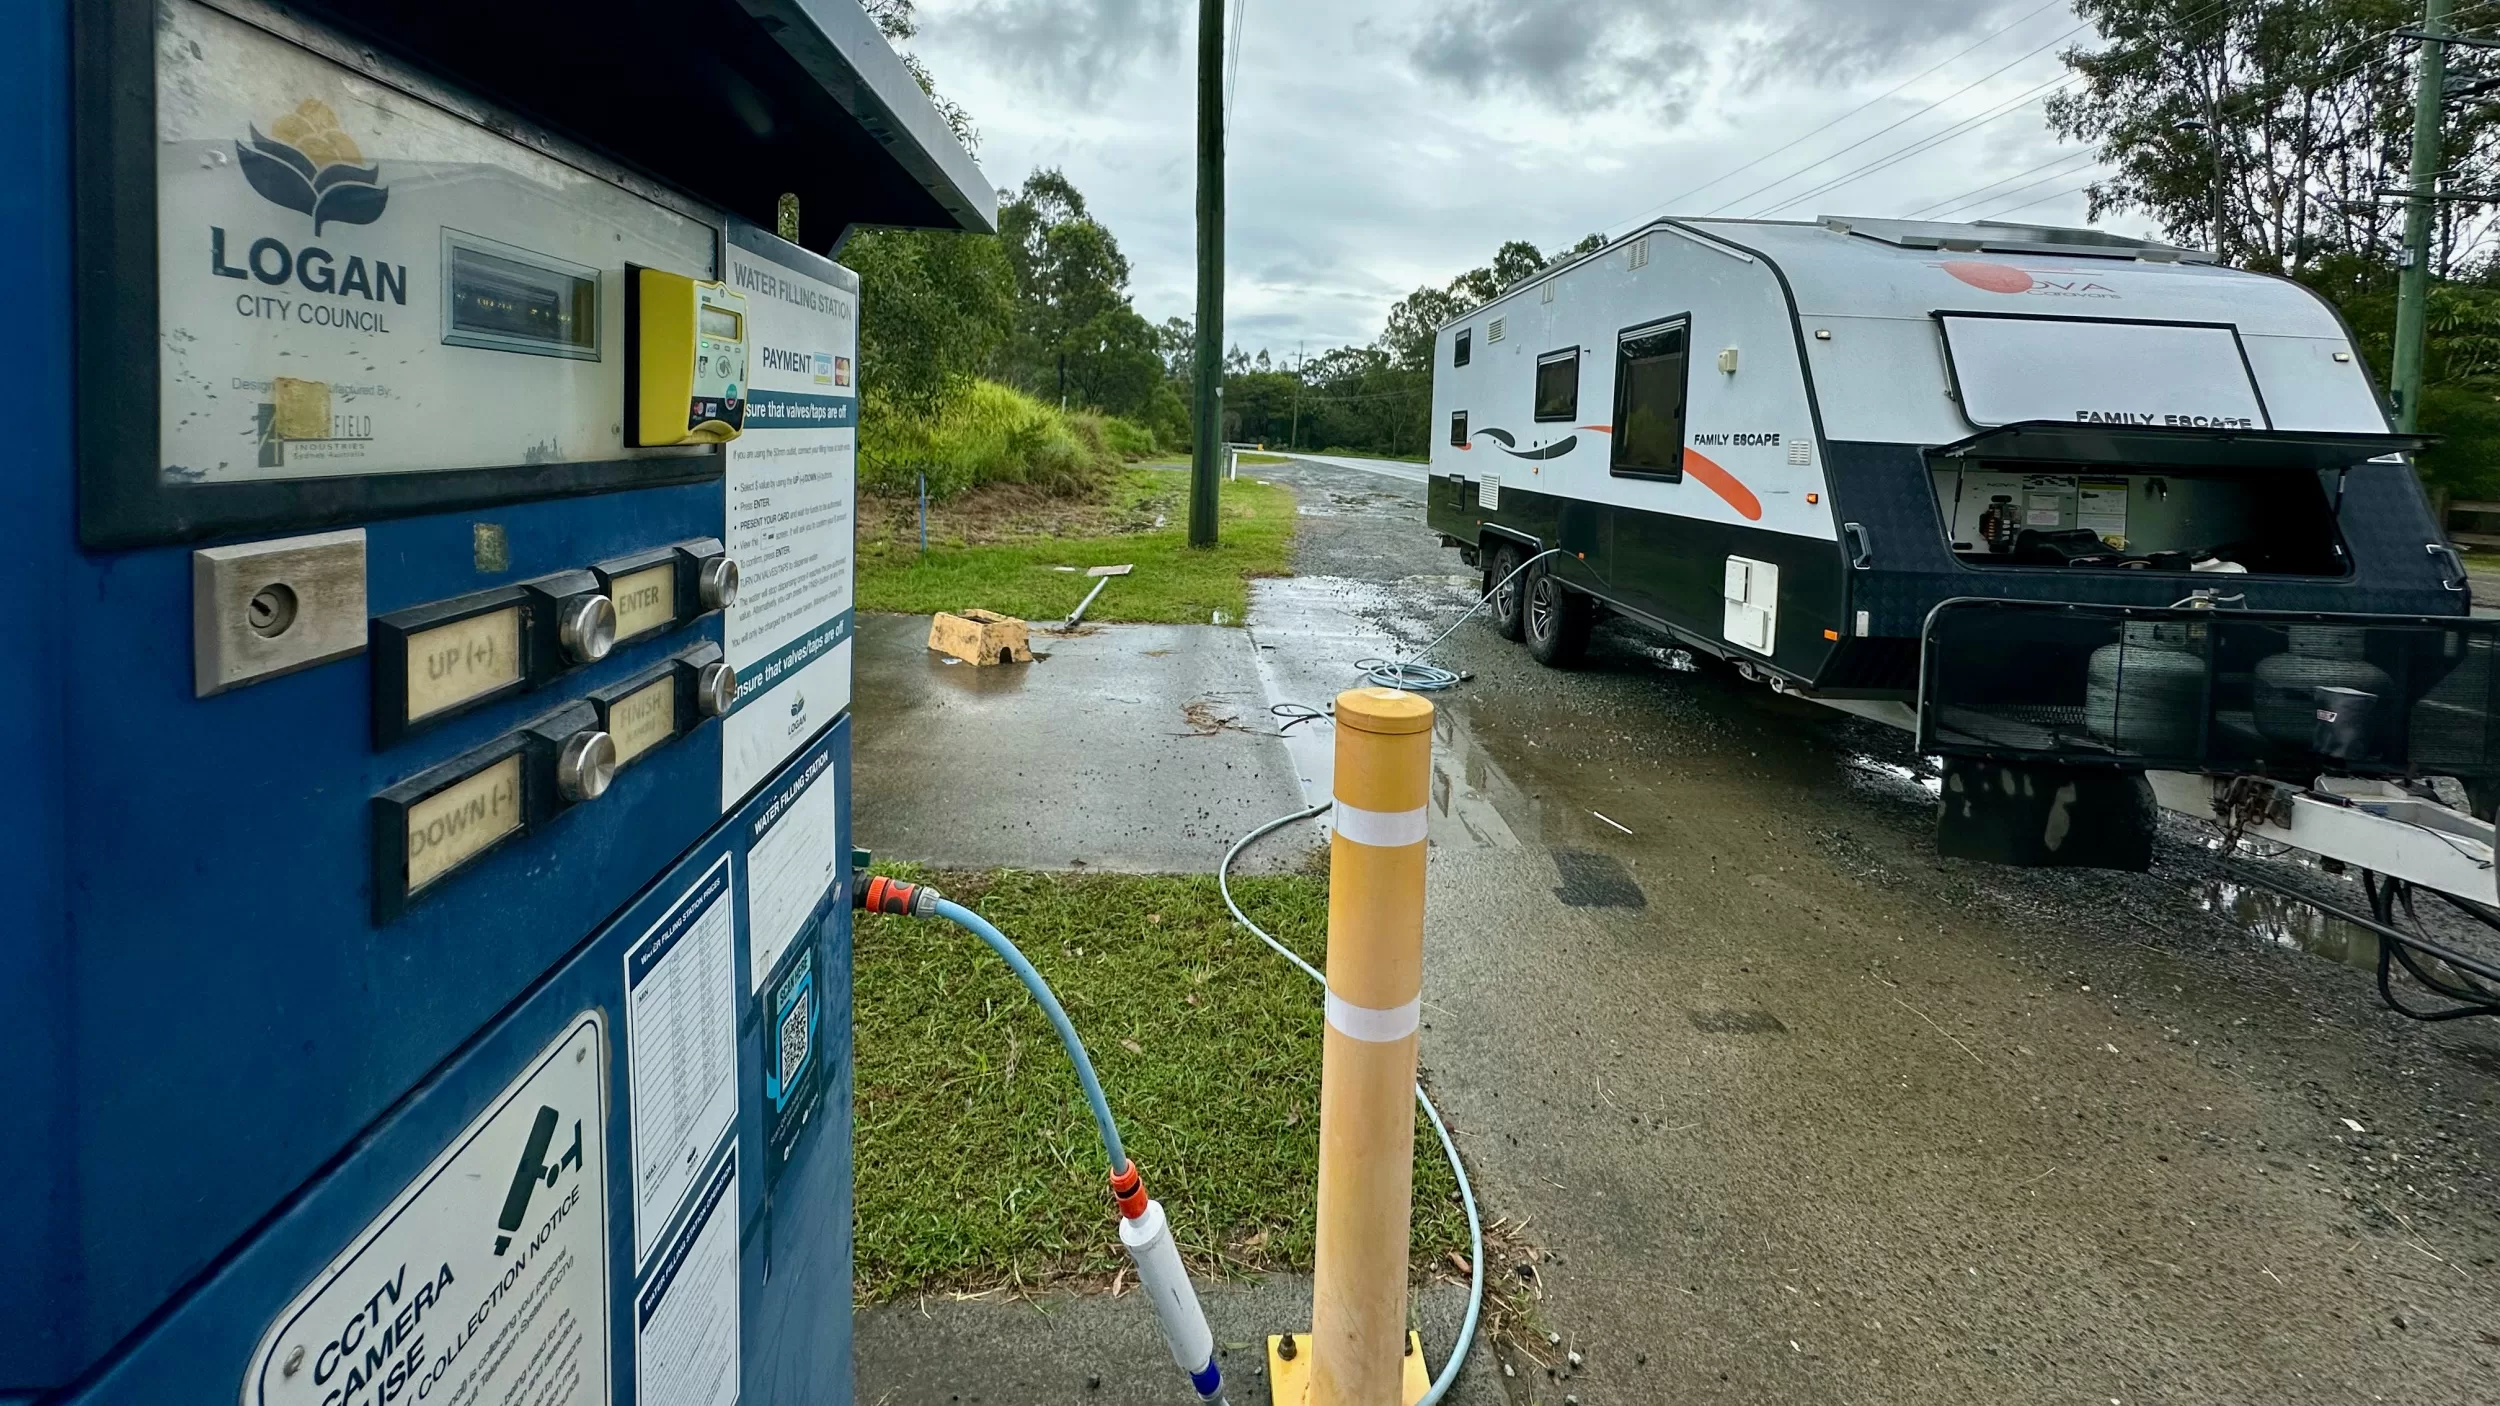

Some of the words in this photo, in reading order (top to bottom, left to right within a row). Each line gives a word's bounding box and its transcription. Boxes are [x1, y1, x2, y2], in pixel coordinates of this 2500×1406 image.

[210, 225, 407, 305] LOGAN
[734, 262, 776, 298] WATER
[779, 280, 816, 314] FILLING
[819, 295, 852, 321] STATION
[236, 294, 291, 323] CITY
[298, 300, 389, 334] COUNCIL
[763, 347, 811, 374] PAYMENT
[232, 377, 276, 394] Design
[328, 383, 374, 396] ufactured
[377, 385, 392, 397] By:
[334, 415, 372, 437] FIELD
[746, 402, 766, 418] sure
[768, 401, 785, 419] that
[786, 402, 827, 422] valves/taps
[828, 407, 838, 419] are
[838, 404, 847, 418] off
[2076, 410, 2154, 425] FAMILY
[295, 443, 365, 451] INDUSTRIES
[1694, 434, 1729, 446] FAMILY
[1733, 433, 1780, 446] ESCAPE
[740, 500, 753, 512] Press
[740, 517, 763, 531] PRESENT
[764, 514, 776, 525] YOUR
[777, 512, 789, 522] CARD
[740, 538, 751, 550] View
[619, 586, 660, 616] ENTER
[427, 649, 459, 681] UP
[465, 635, 494, 671] (+)
[764, 659, 782, 681] that
[783, 635, 824, 670] valves/taps
[824, 629, 835, 645] are
[835, 619, 845, 637] off
[620, 691, 661, 728] FINISH
[788, 713, 807, 736] LOGAN
[754, 801, 780, 836] WATER
[780, 774, 806, 810] FILLING
[804, 749, 829, 782] STATION
[410, 799, 485, 857] DOWN
[491, 778, 514, 818] (-)
[661, 918, 683, 944] FILLING
[682, 895, 704, 922] STATION
[703, 877, 720, 900] PRICES
[638, 987, 650, 1003] MIN
[779, 971, 795, 1005] SCAN
[645, 1164, 657, 1180] MAX
[644, 1276, 666, 1311] WATER
[665, 1240, 686, 1278] FILLING
[685, 1205, 707, 1243] STATION
[706, 1162, 732, 1208] OPERATION
[419, 1252, 526, 1400] COLLECTION
[530, 1184, 580, 1259] NOTICE
[479, 1313, 517, 1370] collecting
[518, 1289, 536, 1320] your
[536, 1244, 567, 1295] personal
[314, 1262, 407, 1386] CCTV
[480, 1332, 519, 1387] Television
[520, 1291, 549, 1334] System
[549, 1255, 574, 1296] (CCTV)
[504, 1369, 527, 1405] being
[528, 1338, 547, 1371] used
[547, 1324, 558, 1343] for
[558, 1307, 570, 1327] the
